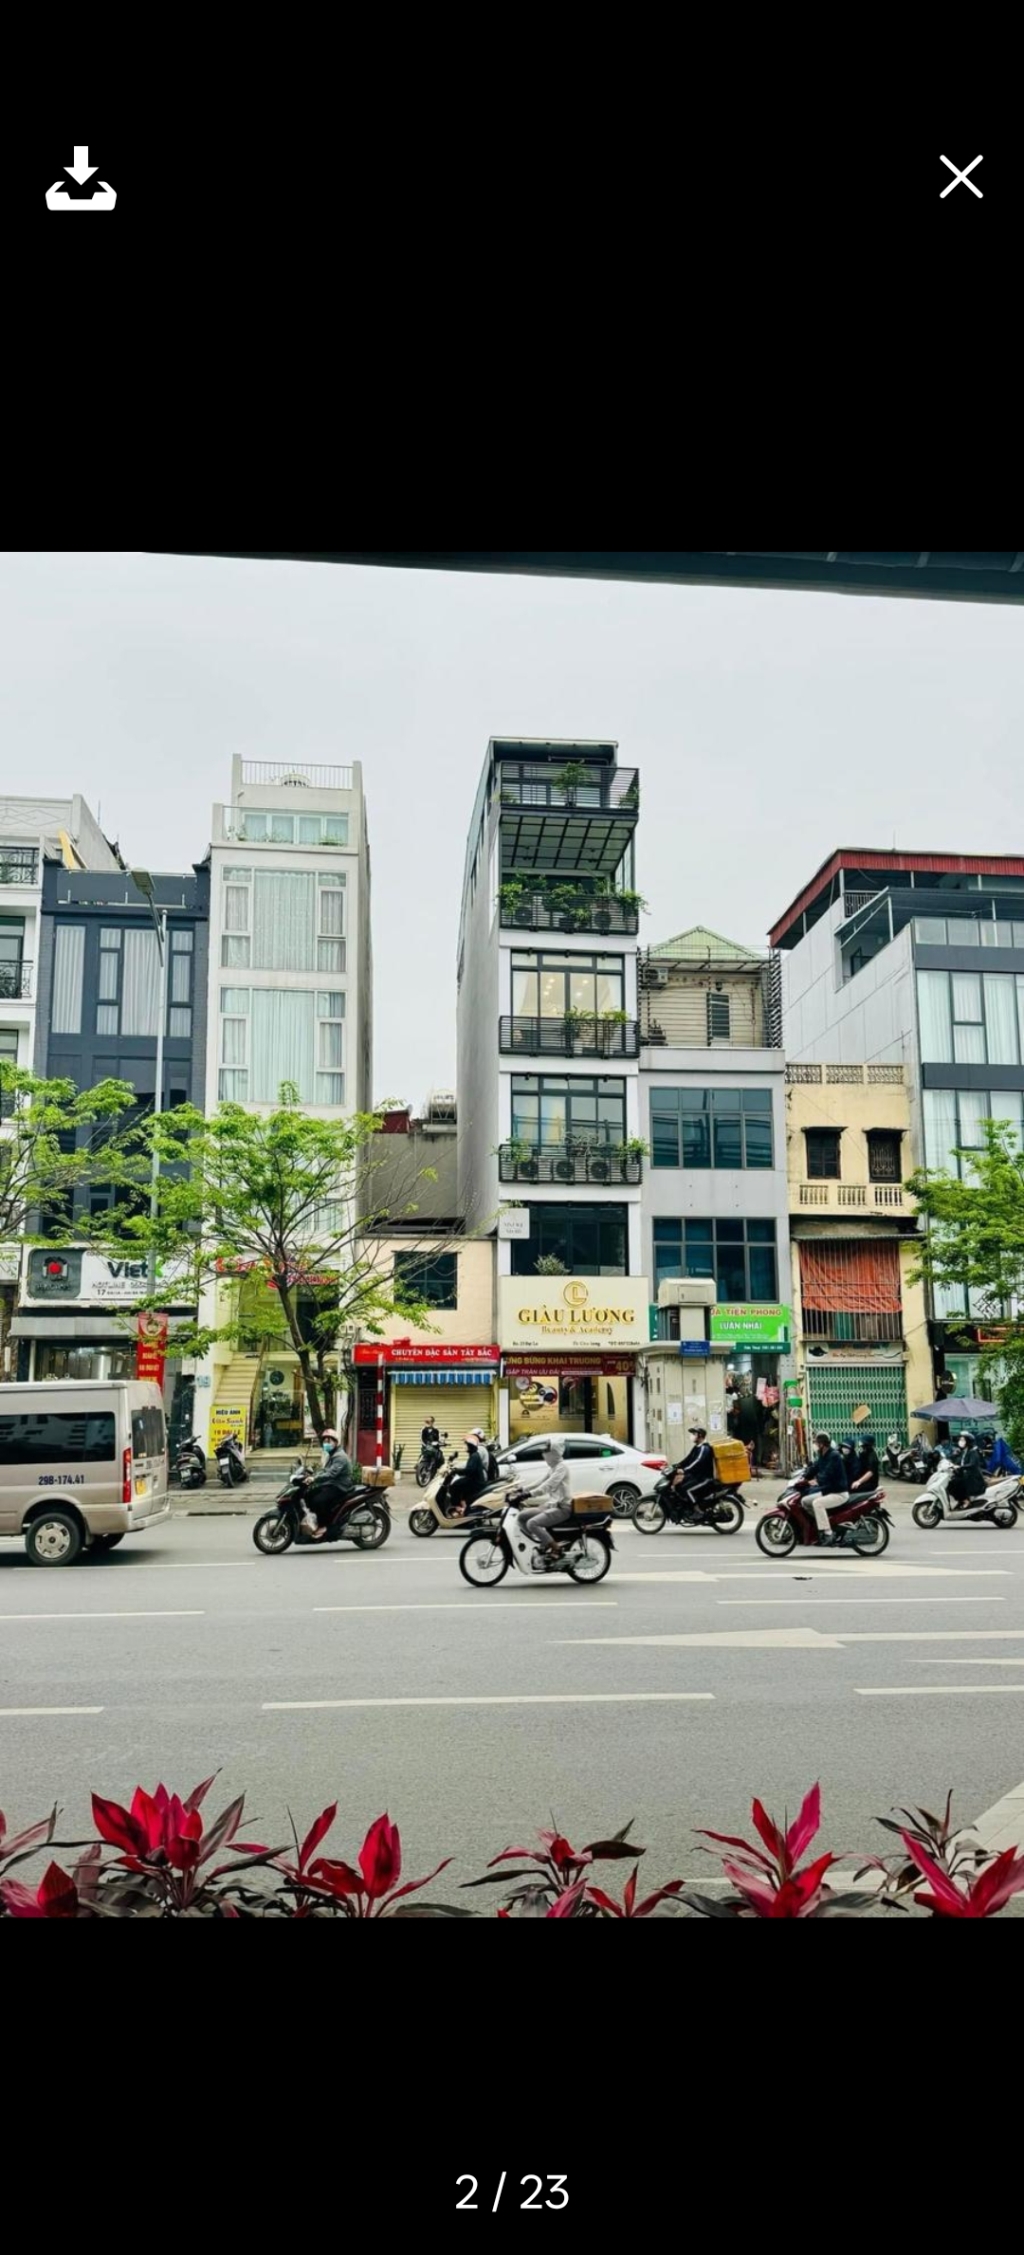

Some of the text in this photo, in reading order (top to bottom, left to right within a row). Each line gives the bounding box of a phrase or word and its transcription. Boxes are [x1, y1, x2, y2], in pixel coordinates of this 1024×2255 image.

[518, 1304, 635, 1323] GIÀU LƯƠNG
[750, 1308, 782, 1316] PHONG
[391, 1347, 423, 1356] CHUYÊN
[547, 1356, 567, 1365] KHAI
